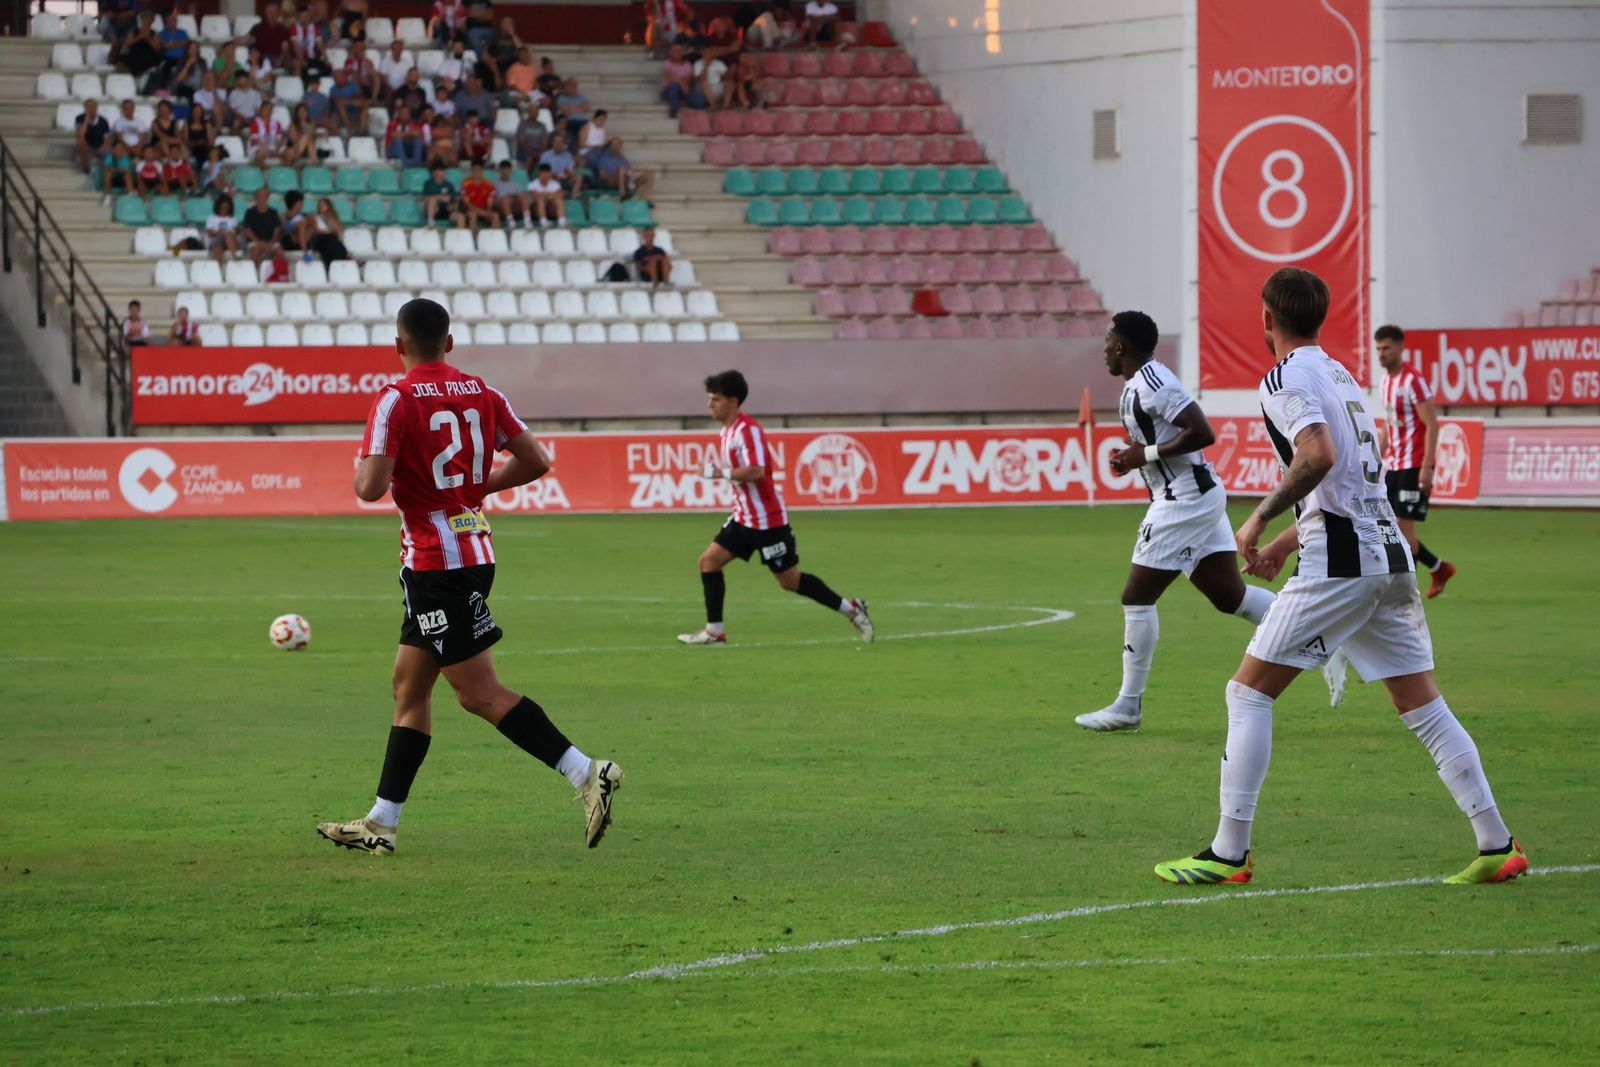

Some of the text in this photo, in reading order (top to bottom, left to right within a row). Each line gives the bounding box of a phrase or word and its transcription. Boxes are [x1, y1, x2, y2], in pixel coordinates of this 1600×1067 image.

[1212, 64, 1353, 89] MONTETORO
[1259, 150, 1307, 227] 8
[411, 382, 443, 397] JOEL
[430, 408, 484, 490] 21
[1346, 401, 1382, 484] 5
[20, 465, 108, 481] Escucha todos
[180, 465, 218, 480] COPE
[183, 480, 245, 495] ZAMORA
[251, 474, 301, 489] COPE.es
[21, 487, 110, 503] los partidos en
[473, 621, 496, 639] ZAMOR
